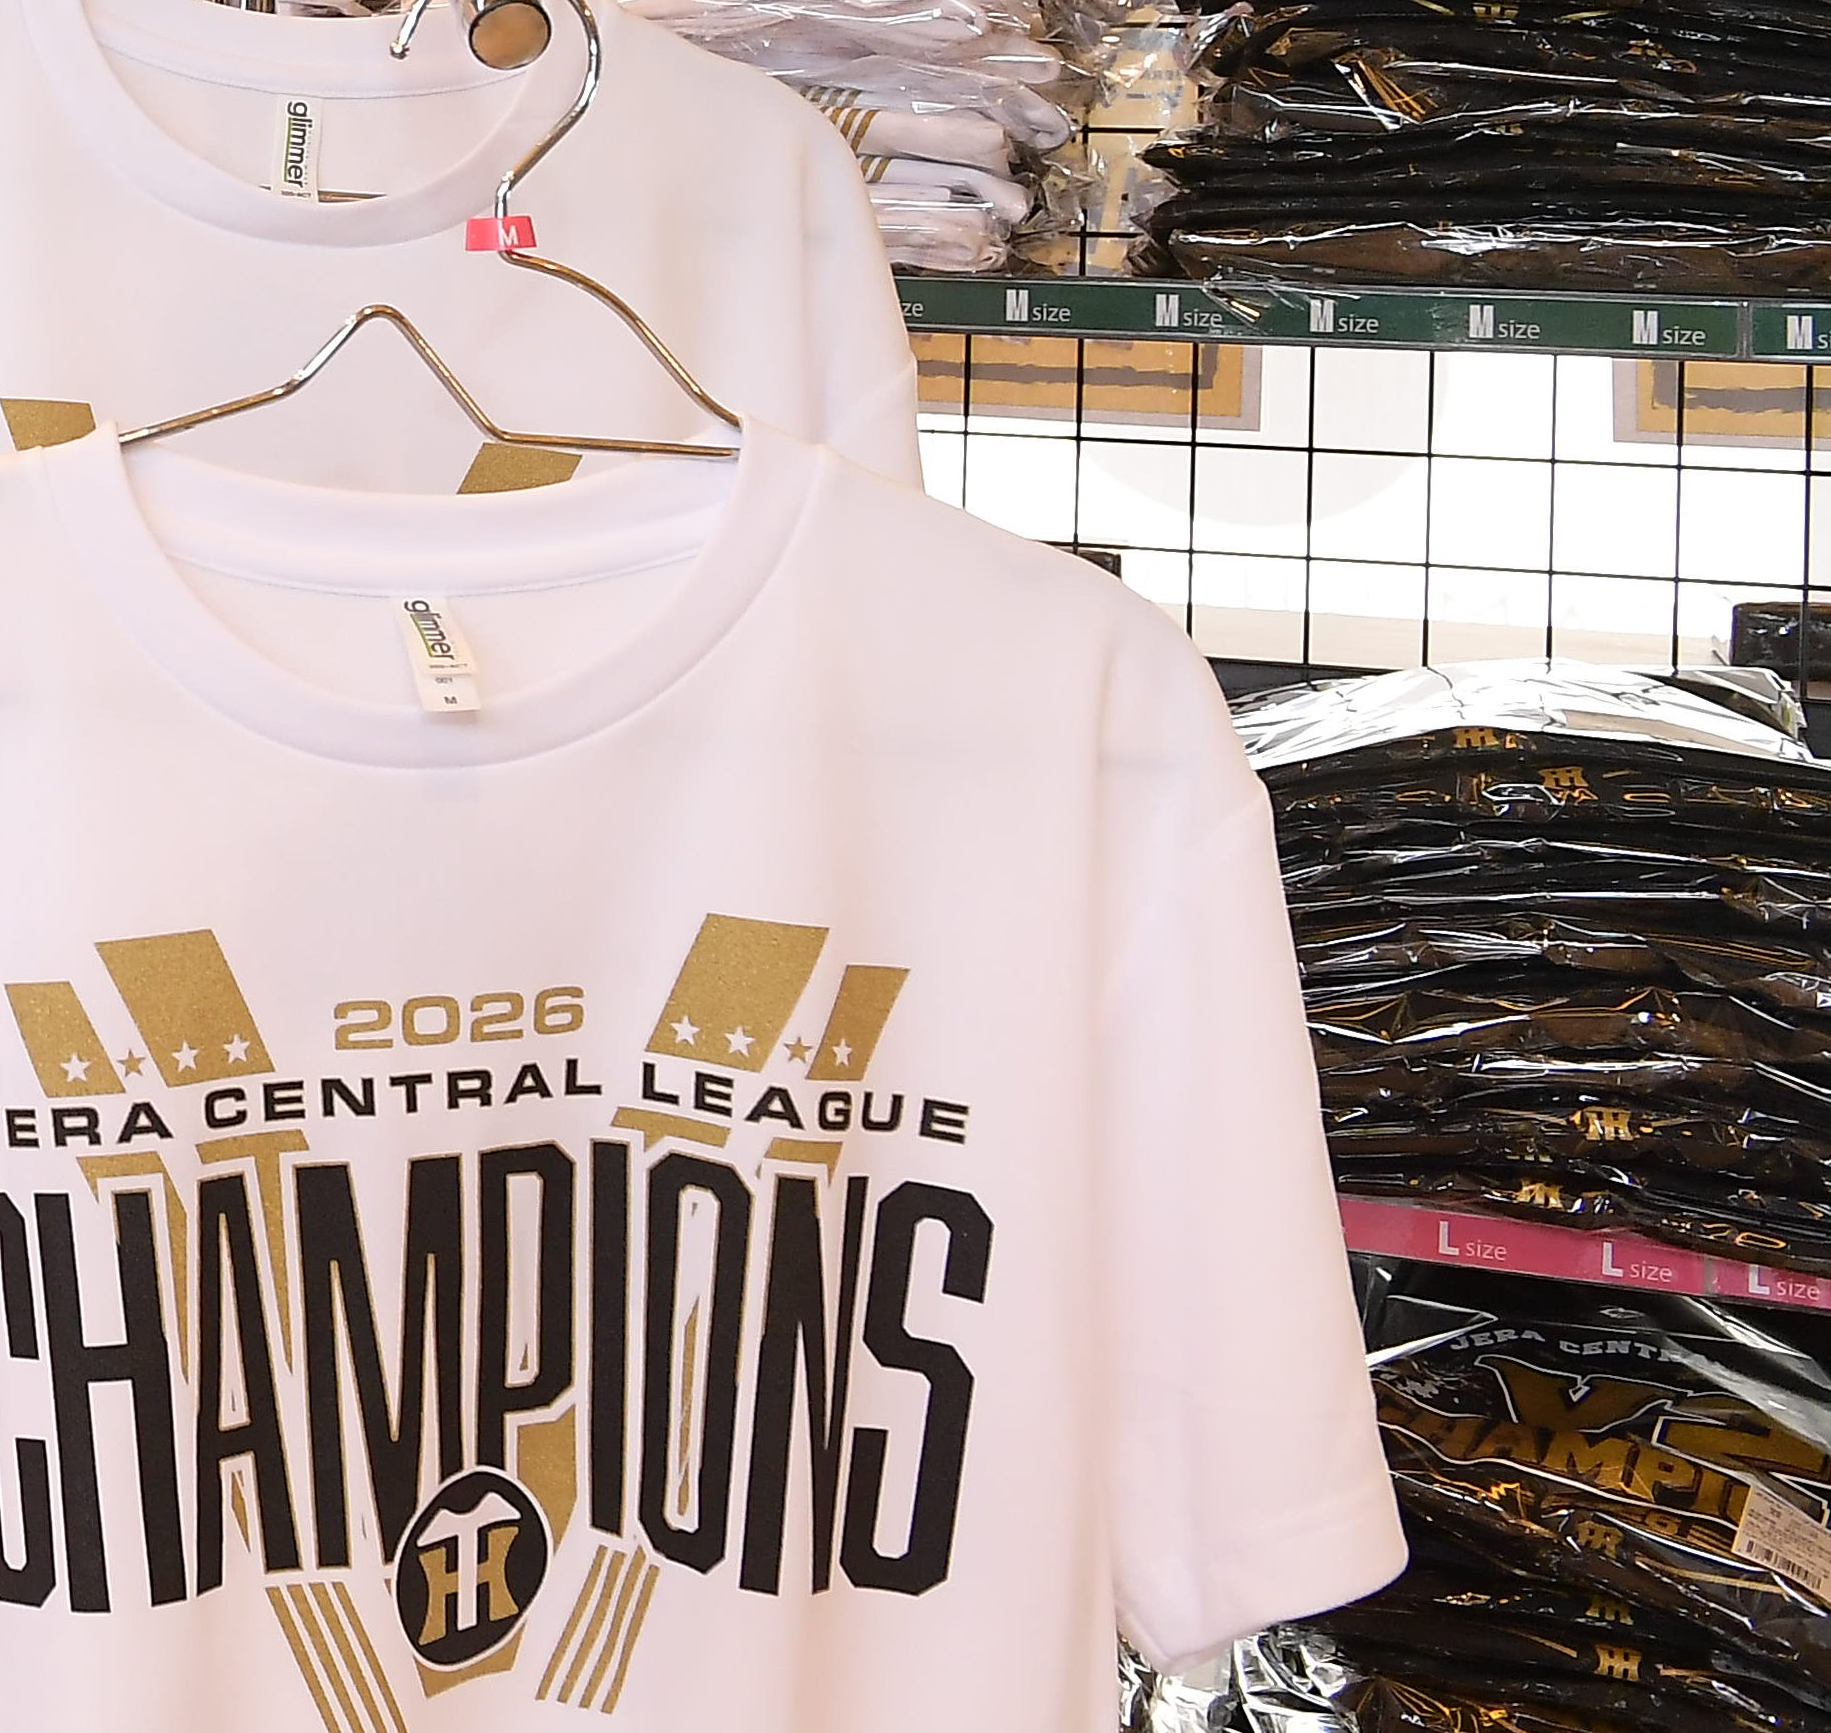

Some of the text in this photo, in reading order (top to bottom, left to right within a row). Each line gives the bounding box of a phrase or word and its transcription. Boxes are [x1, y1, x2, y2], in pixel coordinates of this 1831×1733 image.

[287, 101, 313, 188] glimmer
[498, 225, 520, 248] M
[1005, 289, 1028, 322] M
[1031, 302, 1071, 323] size
[1155, 293, 1179, 327] M
[1182, 306, 1223, 329] size
[1310, 299, 1334, 333] M
[1337, 311, 1379, 335] size
[1469, 304, 1494, 339] M
[1497, 317, 1540, 341] size
[1633, 309, 1657, 346] M
[1661, 324, 1706, 347] size
[1787, 314, 1813, 350] M
[332, 985, 586, 1052] 2026
[202, 1056, 603, 1133] CENTRAL
[640, 1061, 970, 1145] LEAGUE
[1439, 1221, 1820, 1301] L size L size L size
[1450, 1329, 1544, 1352] JERA
